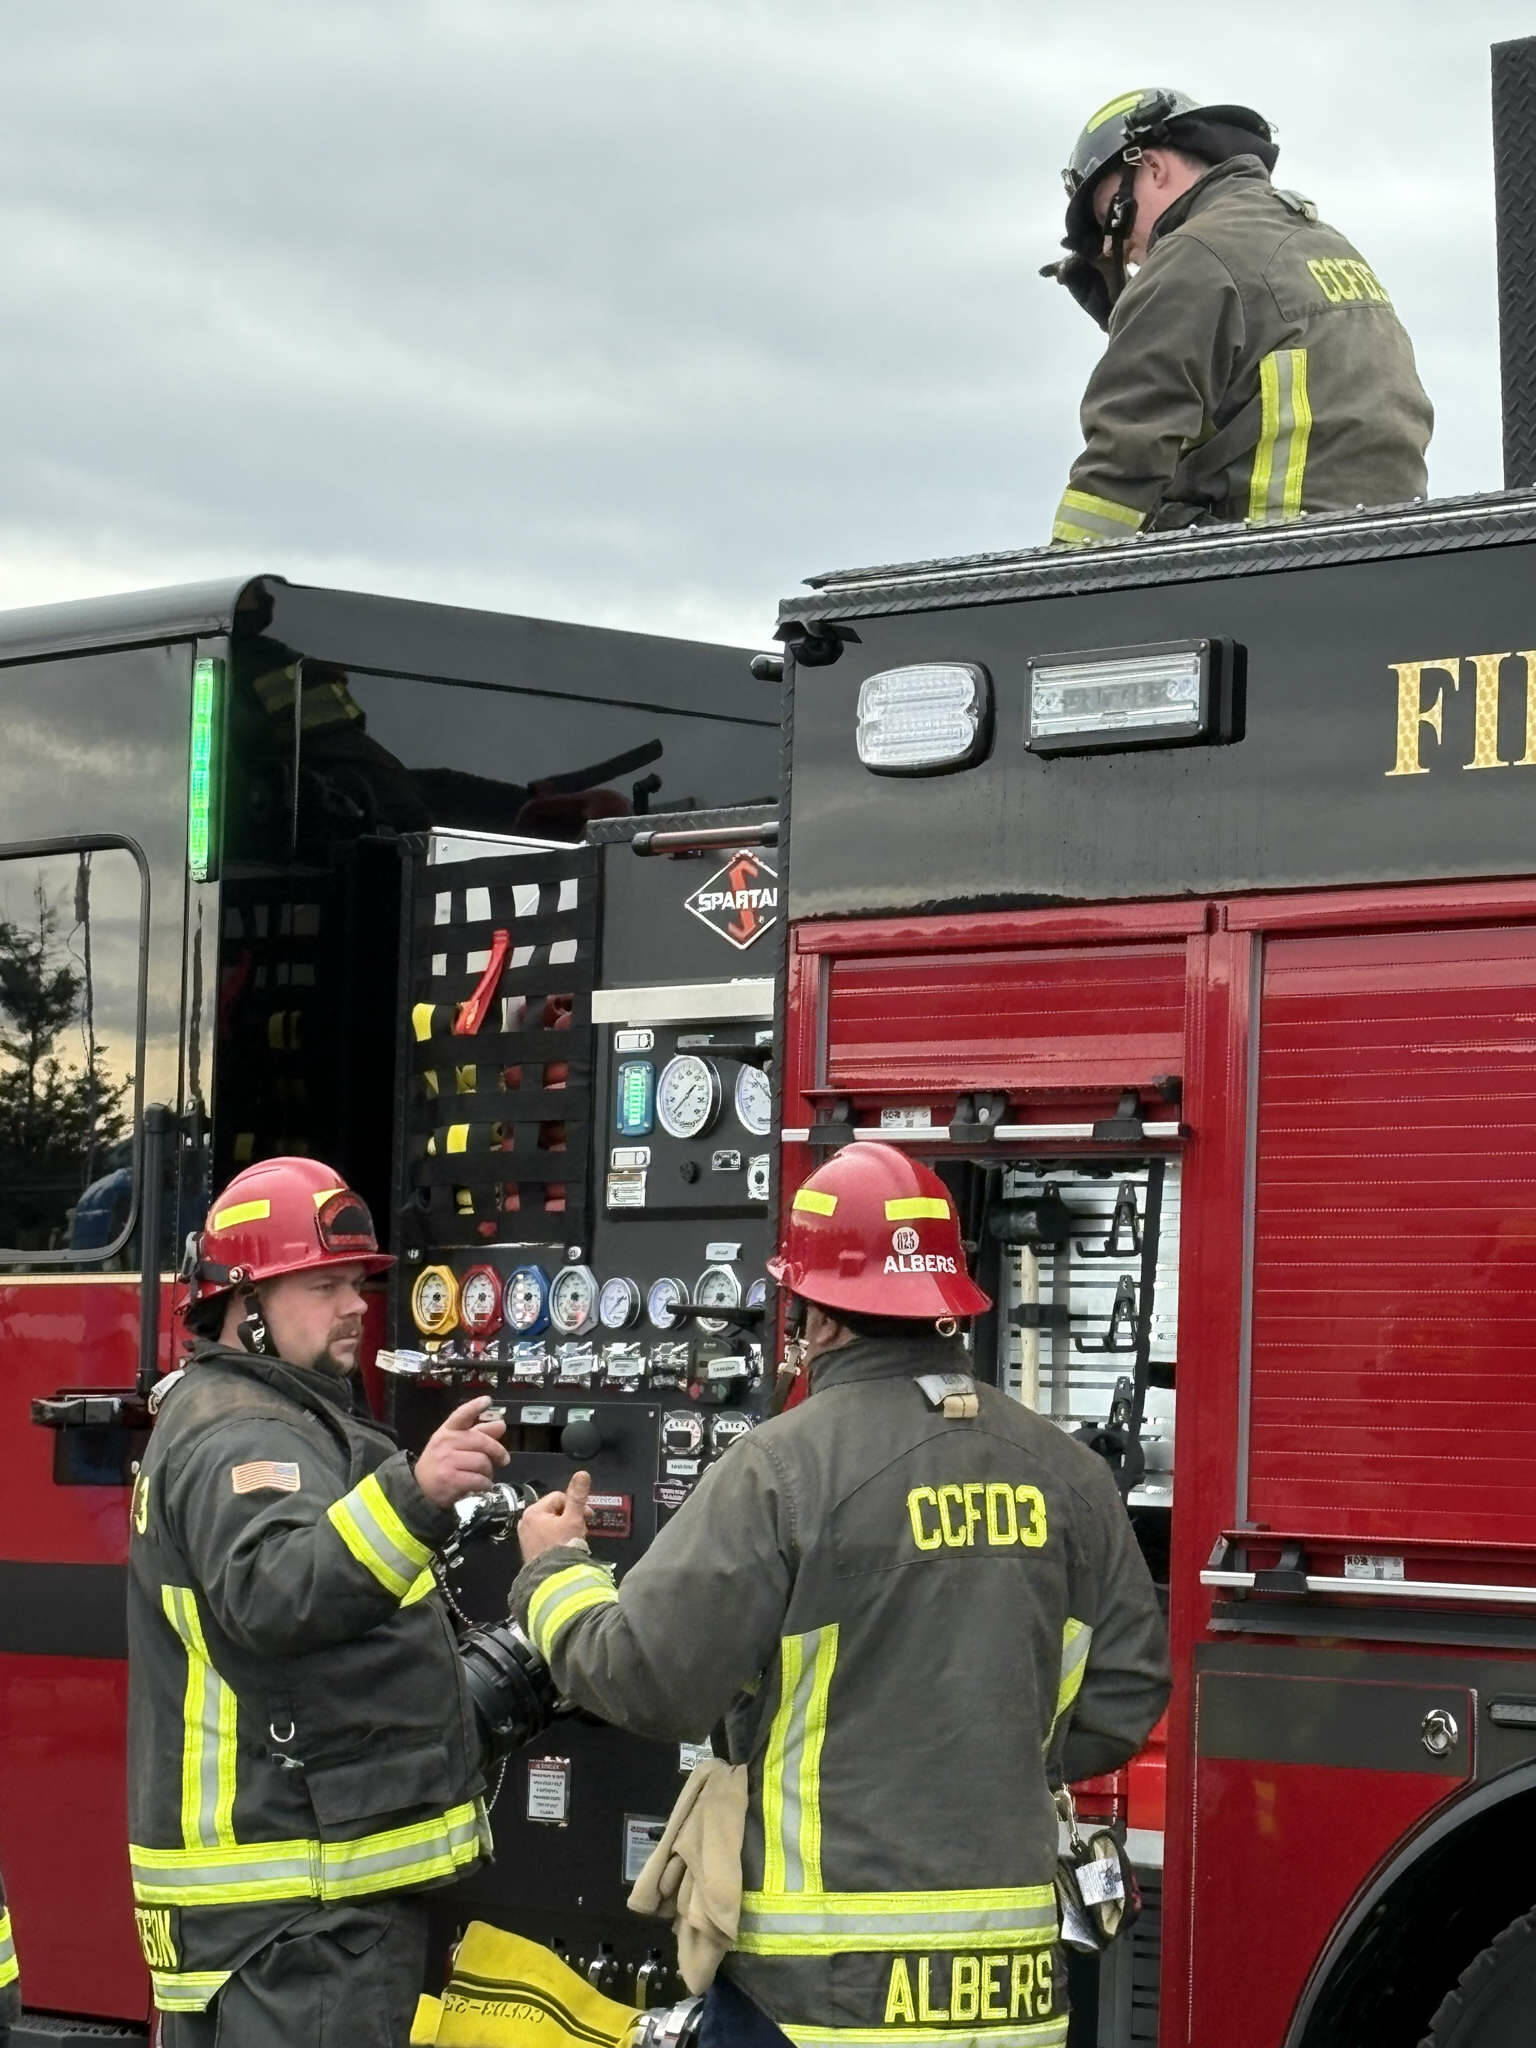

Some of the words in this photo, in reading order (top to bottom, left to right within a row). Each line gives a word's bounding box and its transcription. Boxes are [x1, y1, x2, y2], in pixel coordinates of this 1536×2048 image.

[883, 1254, 958, 1275] ALBERS
[907, 1482, 1048, 1551] CCFD3
[884, 1950, 1053, 2023] ALBERS
